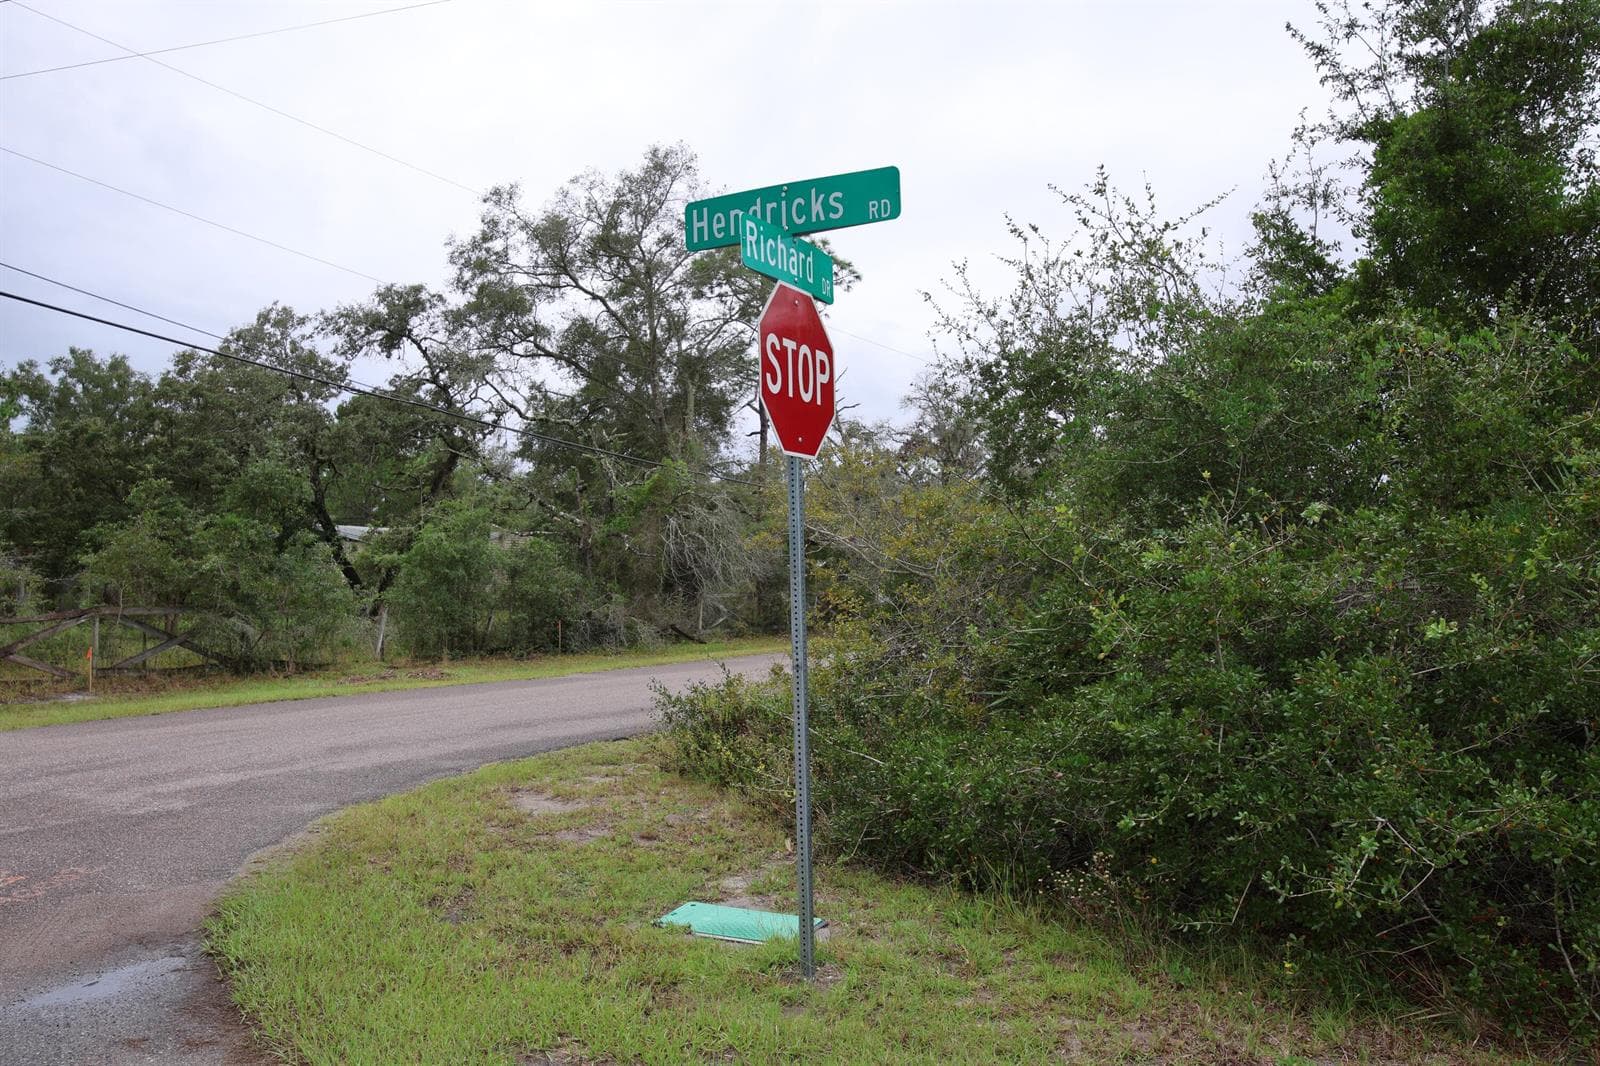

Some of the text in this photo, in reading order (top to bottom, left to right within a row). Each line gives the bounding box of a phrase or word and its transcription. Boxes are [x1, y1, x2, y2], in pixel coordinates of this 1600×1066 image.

[692, 187, 891, 243] Hendricks RD
[745, 219, 832, 298] Richard DR
[765, 332, 831, 406] STOP
